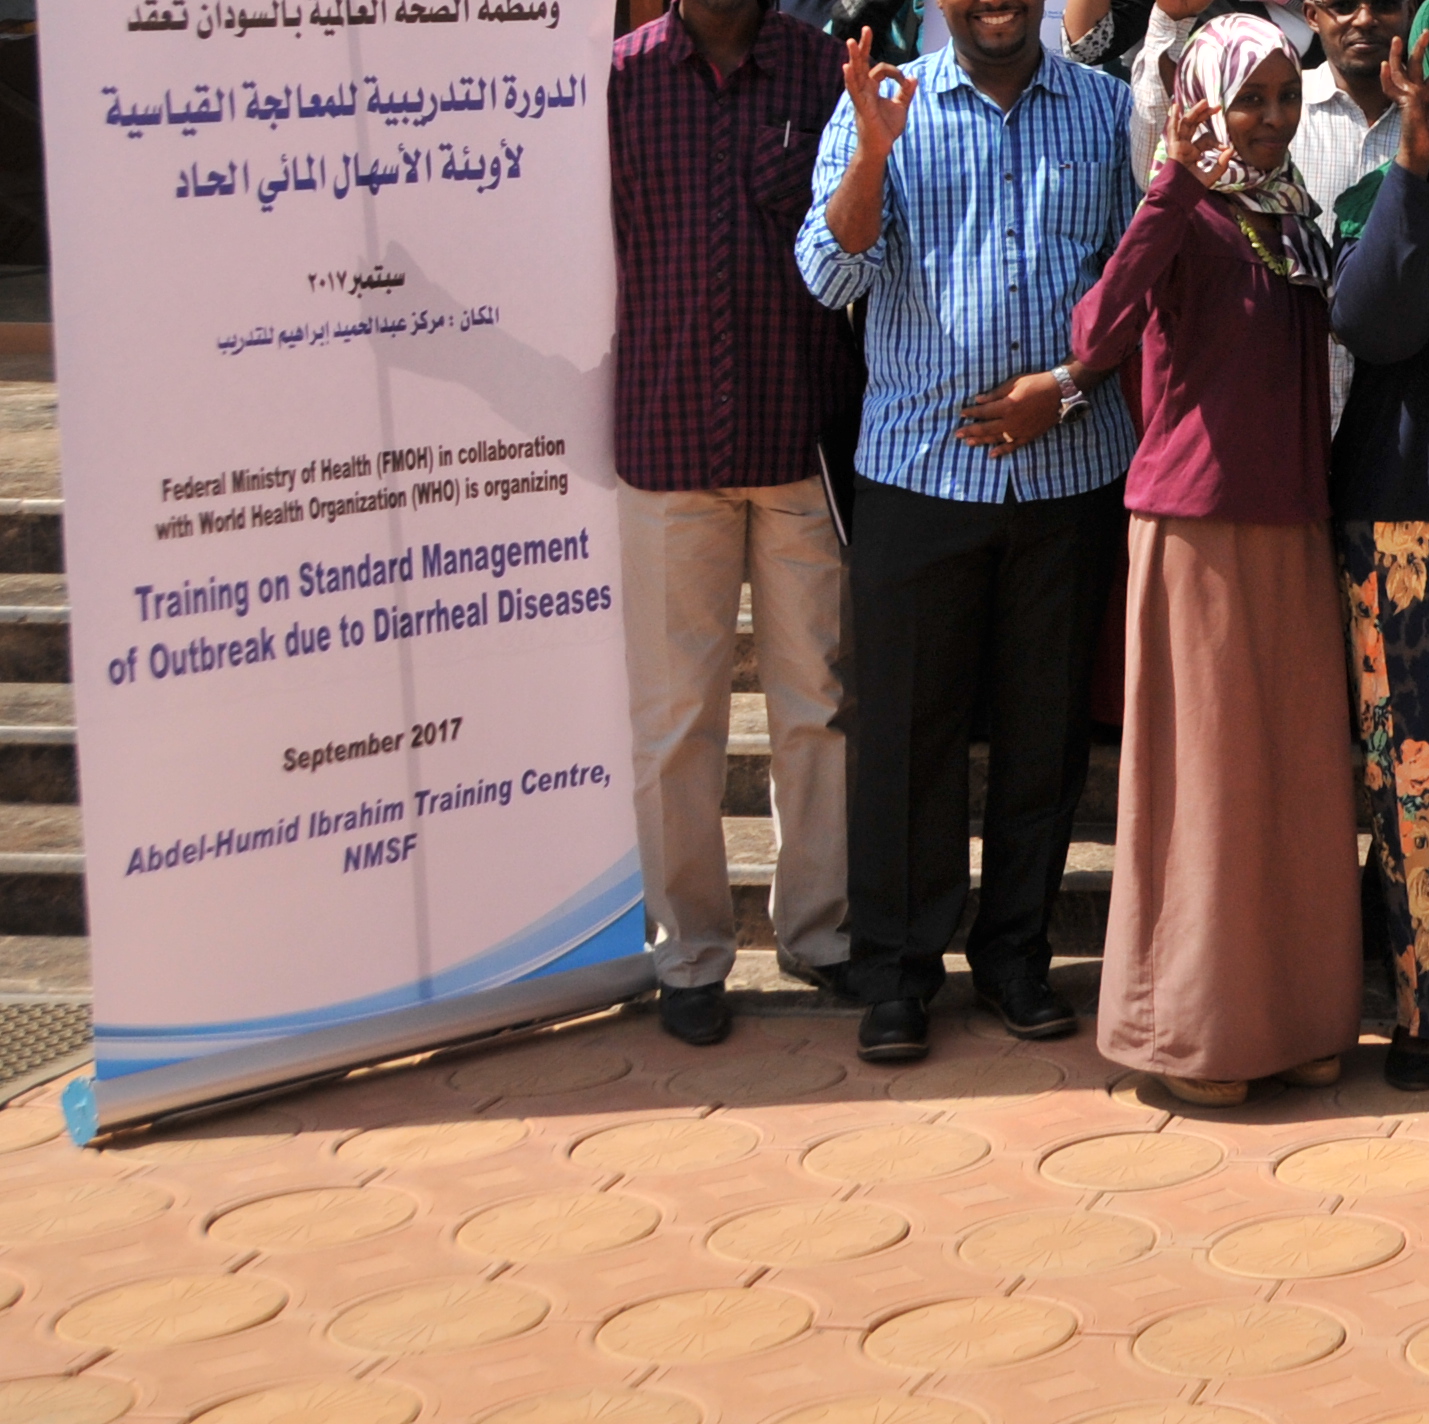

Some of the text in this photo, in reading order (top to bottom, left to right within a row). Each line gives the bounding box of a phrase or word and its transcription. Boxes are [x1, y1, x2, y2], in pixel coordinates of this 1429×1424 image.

[101, 72, 587, 139] الدورة التدريبية للمعالجة القياسية
[175, 159, 250, 198] الحاد
[257, 152, 326, 212] المائي
[437, 138, 524, 194] لأوبئة
[348, 265, 406, 299] سبتمبر
[410, 309, 445, 336] مركز
[460, 304, 500, 332] المكان
[162, 435, 566, 503] Federal Ministry of Health (FMOH) in collaboration
[156, 471, 569, 541] with World Health Organization (WHO) is organizing
[135, 527, 591, 623] Training on Standard Management
[107, 581, 613, 687] of Outbreak due to Diarrheal Diseases
[282, 716, 464, 774] September 2017
[125, 759, 612, 877] Abdel-Humid Ibrahim Training Centre,
[342, 833, 418, 876] NMSF
